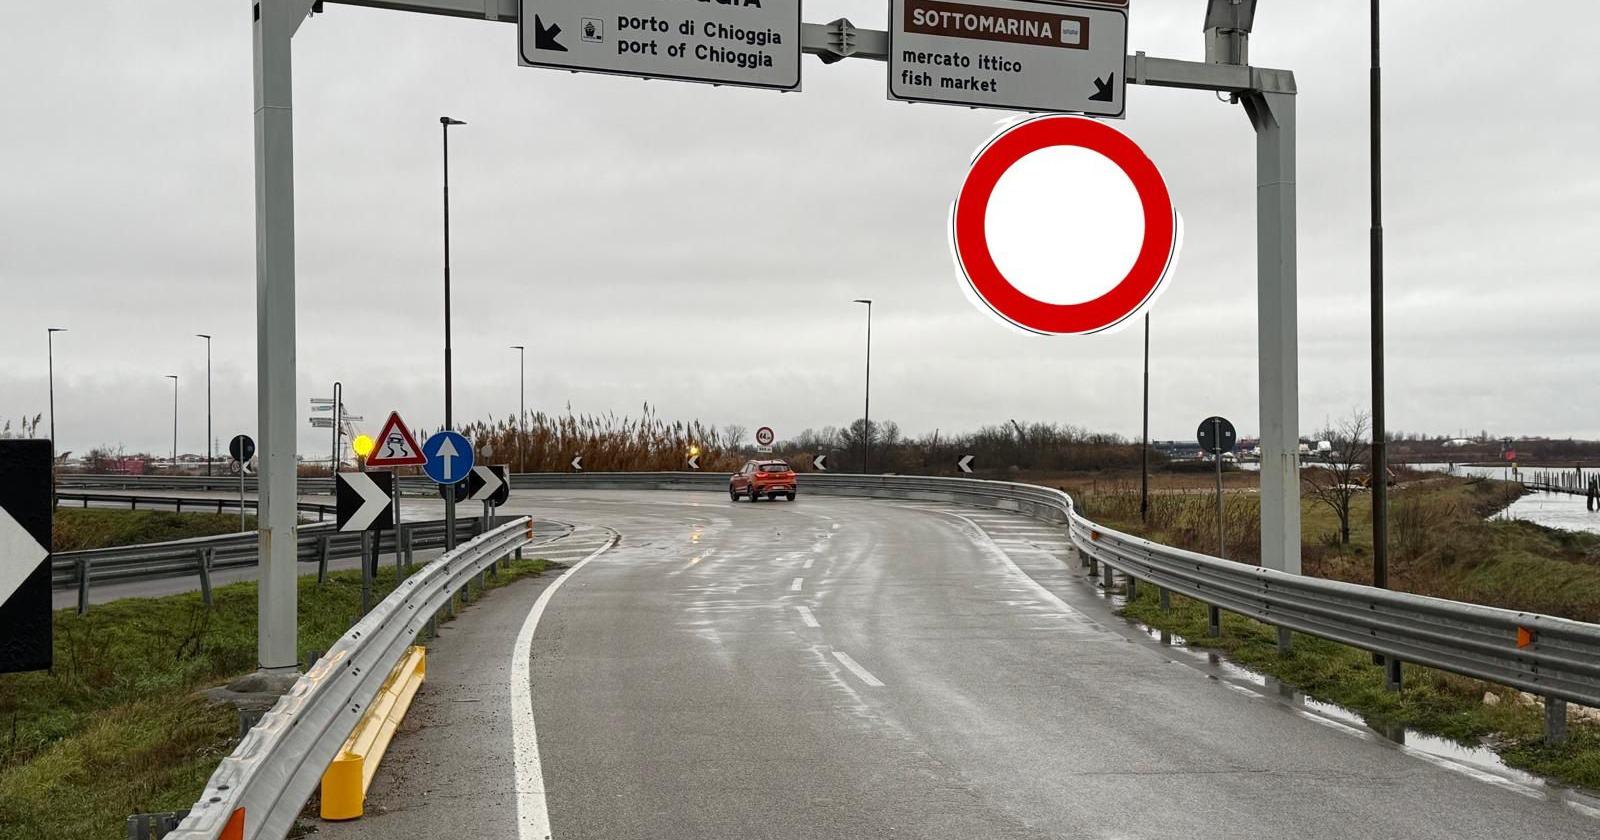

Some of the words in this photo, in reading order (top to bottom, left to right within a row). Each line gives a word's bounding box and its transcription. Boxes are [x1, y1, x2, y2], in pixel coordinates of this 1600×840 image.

[617, 15, 669, 32] porto
[678, 20, 695, 36] di
[703, 22, 782, 45] Chioggia
[913, 8, 1053, 39] SOTTOMARINA
[617, 39, 658, 55] port
[667, 43, 686, 58] of
[695, 45, 773, 68] Chioggia
[902, 50, 970, 67] mercato
[978, 54, 1021, 72] ittico
[901, 70, 932, 86] fish
[940, 76, 997, 92] market
